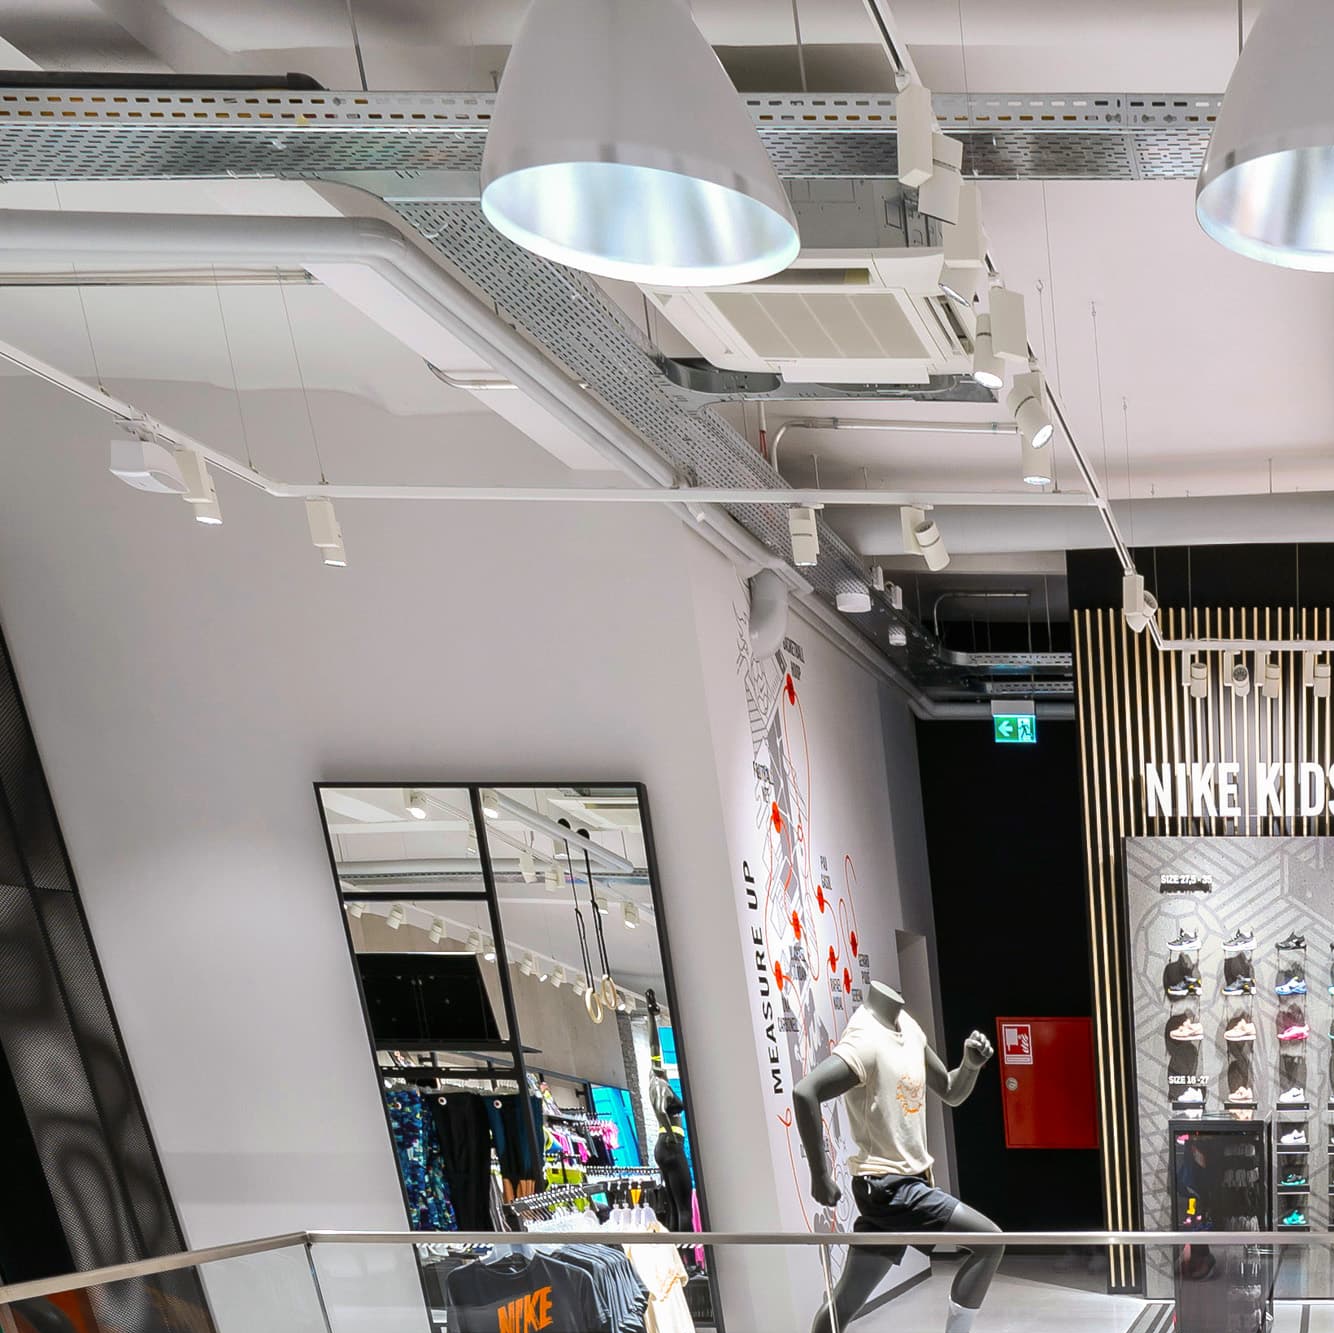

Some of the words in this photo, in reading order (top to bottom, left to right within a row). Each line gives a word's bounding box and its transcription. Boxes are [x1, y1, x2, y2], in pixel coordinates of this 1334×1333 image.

[1146, 762, 1242, 817] NIKE
[743, 860, 758, 910] UP
[1160, 874, 1179, 884] SIZE
[751, 925, 783, 1095] MEASURE
[1168, 1075, 1186, 1085] SIZE
